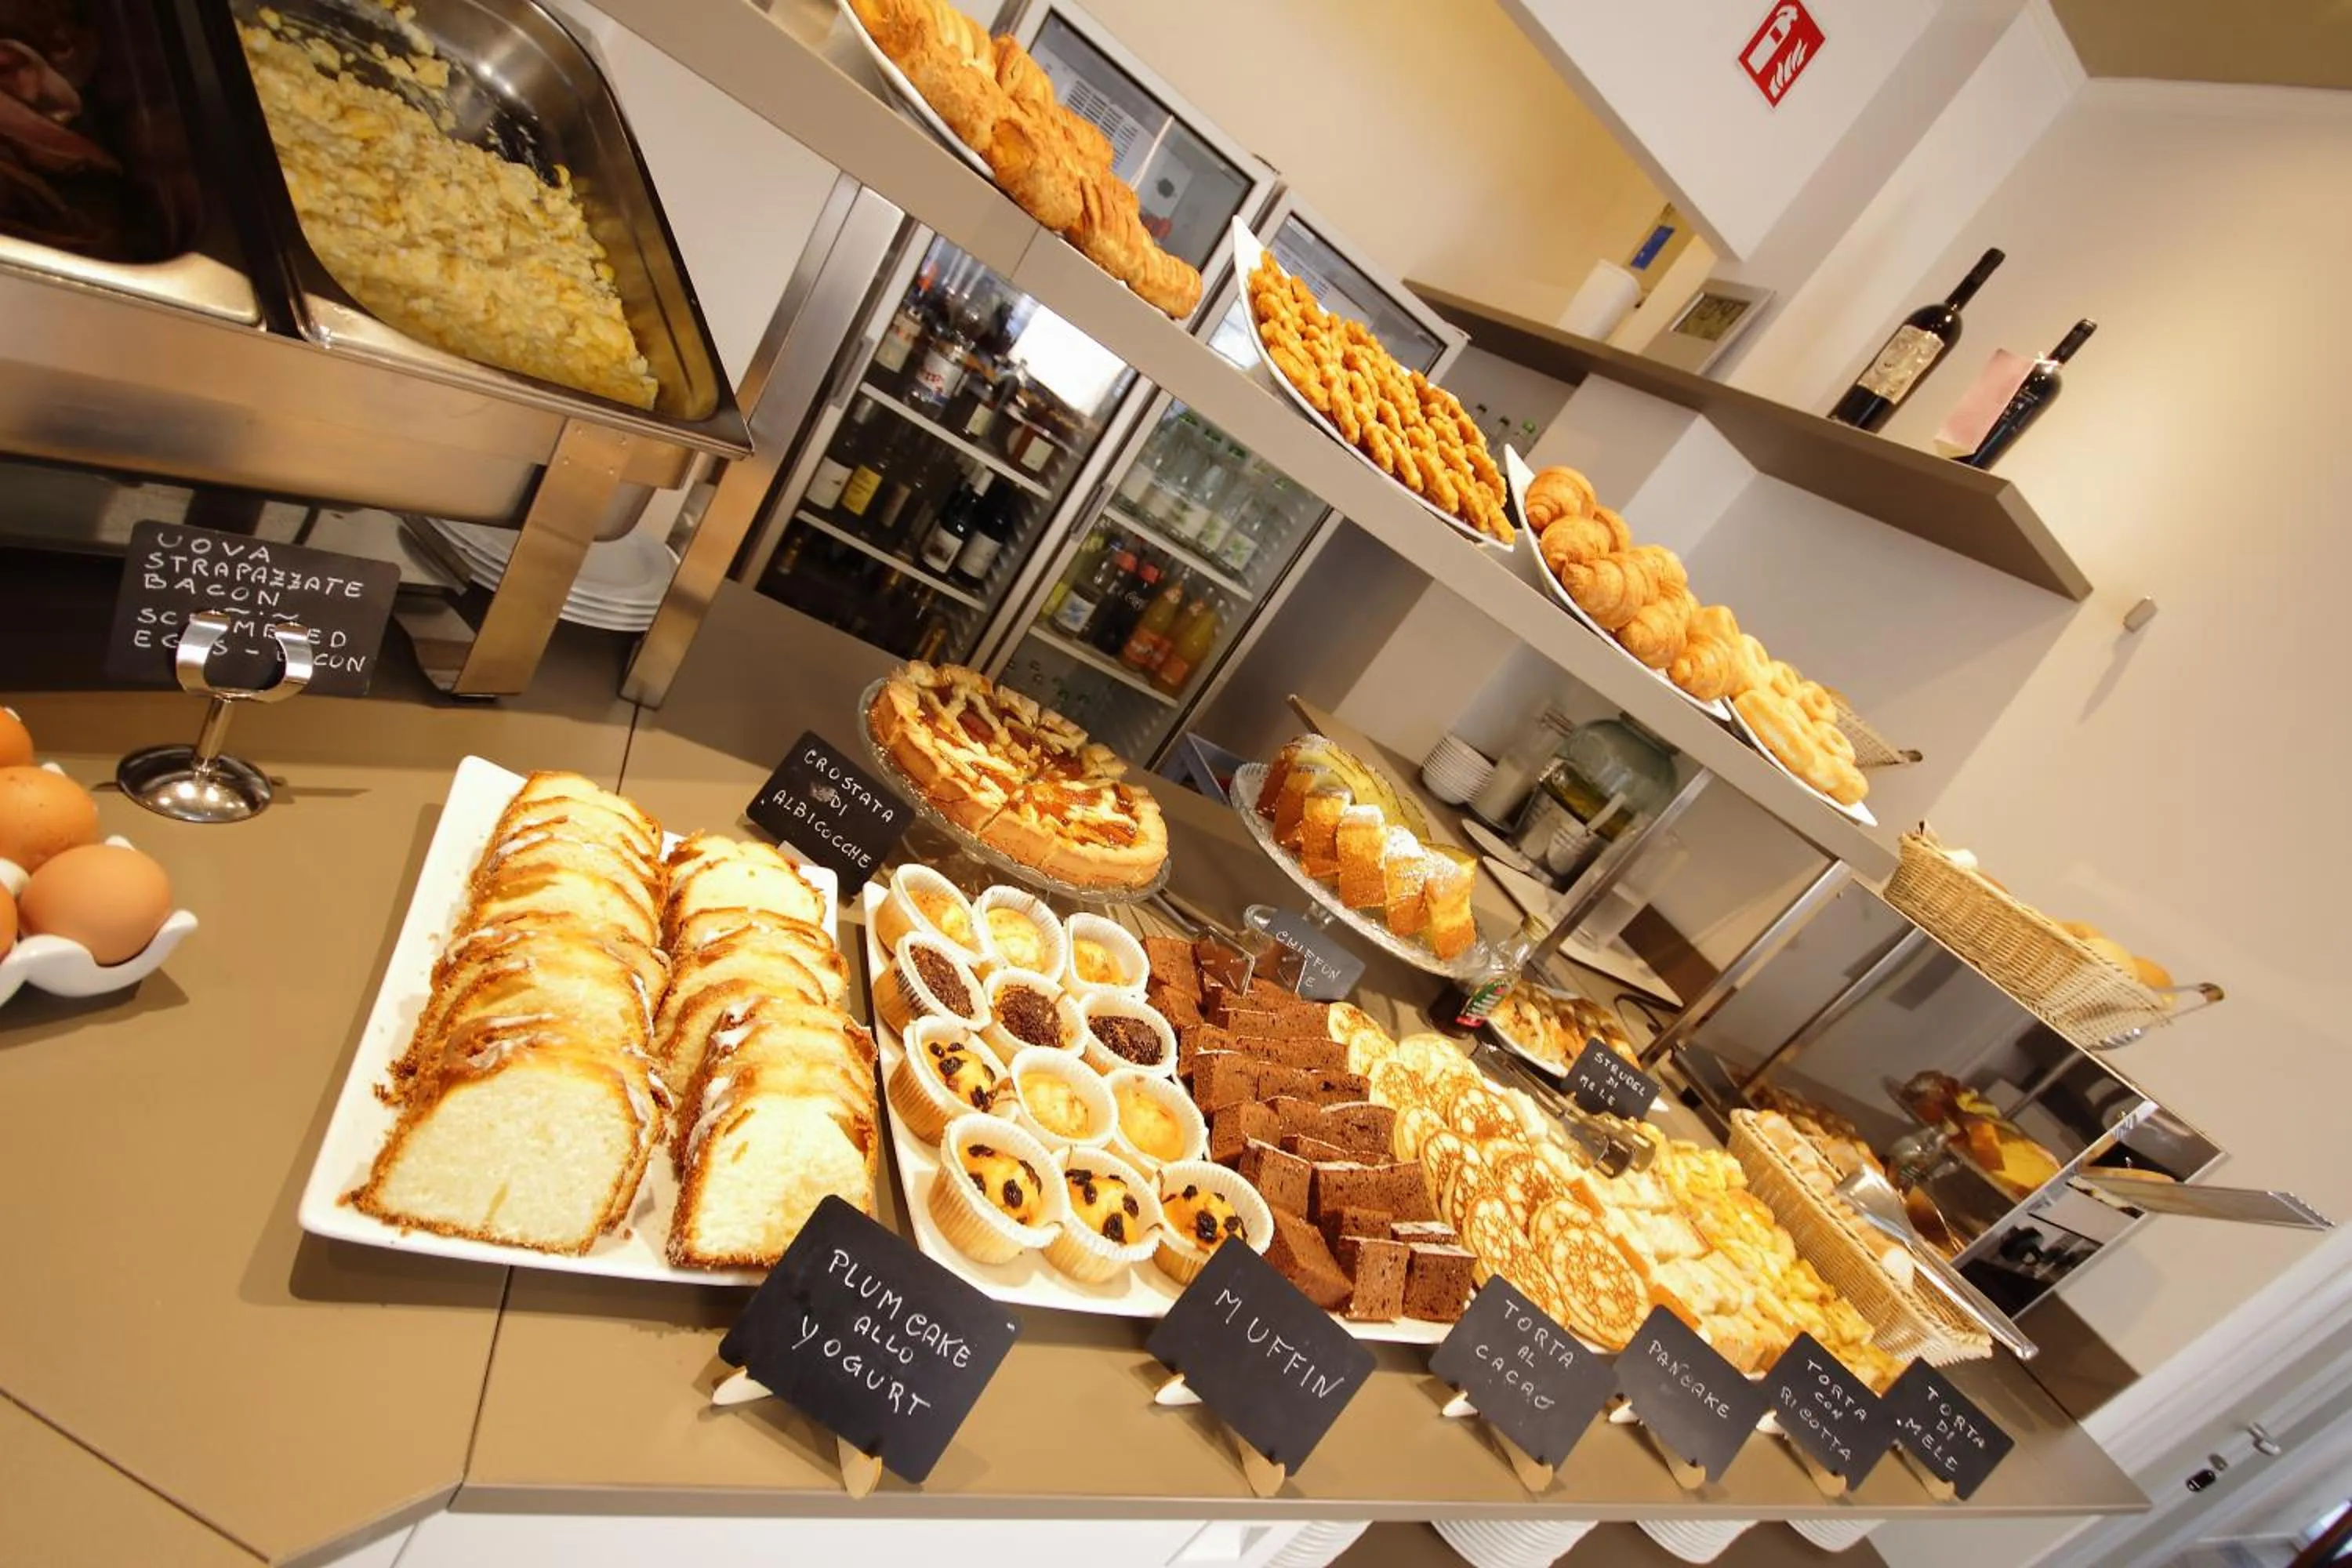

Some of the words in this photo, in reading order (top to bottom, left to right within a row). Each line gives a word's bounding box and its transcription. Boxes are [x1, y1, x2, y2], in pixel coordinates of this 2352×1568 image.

[144, 552, 365, 597] STRAPAZZATE
[158, 532, 270, 564] UOVA
[144, 573, 280, 606] BACON
[134, 630, 228, 655] EGS
[804, 749, 894, 822] CROSTATA
[830, 793, 848, 816] DI
[772, 789, 872, 868] ALBICOCCHE
[1594, 1051, 1646, 1097] STRUDEL
[854, 1316, 913, 1363] ALLO
[1215, 1288, 1345, 1398] MUFFIN
[1504, 1299, 1574, 1368] TORTA
[1517, 1345, 1534, 1367] AL
[792, 1316, 931, 1415] YOGURT
[1475, 1345, 1555, 1410] CACAO
[1648, 1339, 1730, 1418] PANCAKE
[1806, 1359, 1867, 1421] TORTA
[1780, 1385, 1851, 1461] RICOTTA
[1814, 1392, 1842, 1420] CON
[1927, 1385, 1985, 1448] TORTA
[1936, 1419, 1955, 1440] DI
[1905, 1417, 1958, 1472] MELE
